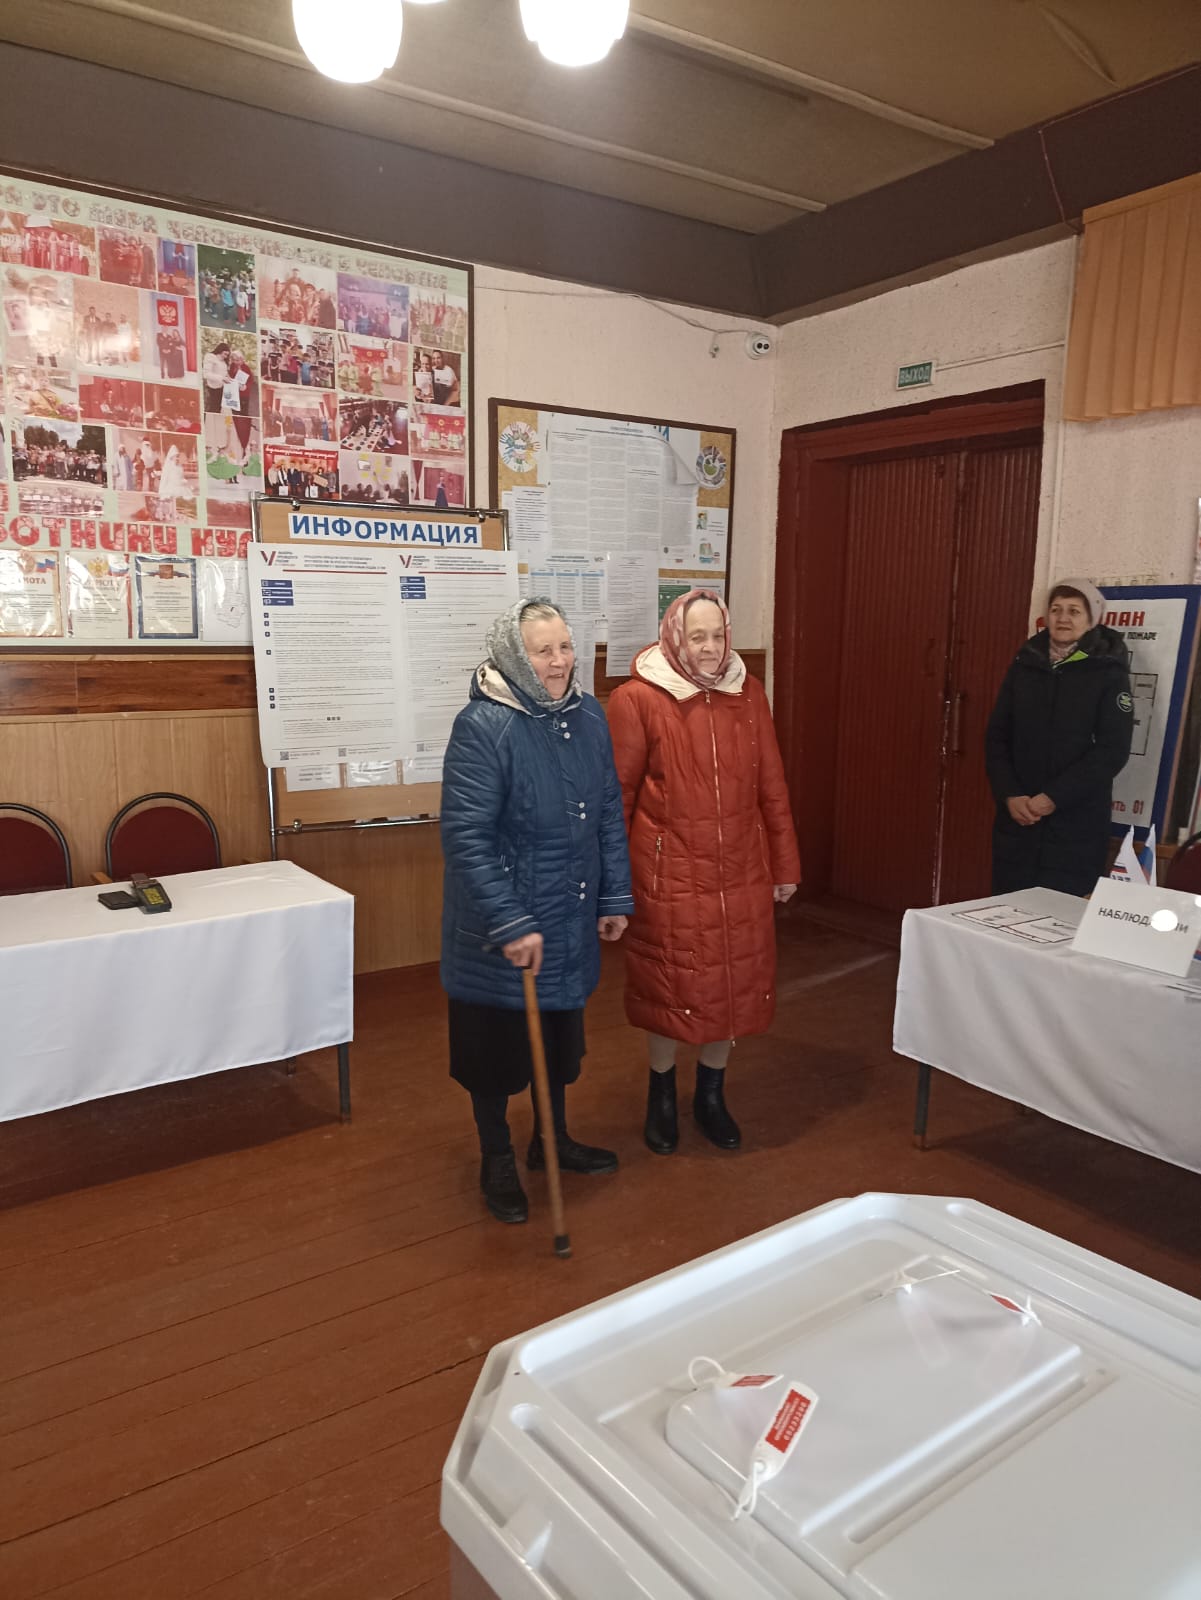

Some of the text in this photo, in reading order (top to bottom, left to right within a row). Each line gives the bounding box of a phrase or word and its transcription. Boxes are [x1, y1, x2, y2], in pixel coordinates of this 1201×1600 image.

[899, 365, 930, 384] ВЫХОД
[292, 515, 478, 546] ИНФОРМАЦИЯ
[1099, 611, 1145, 626] ЛАН
